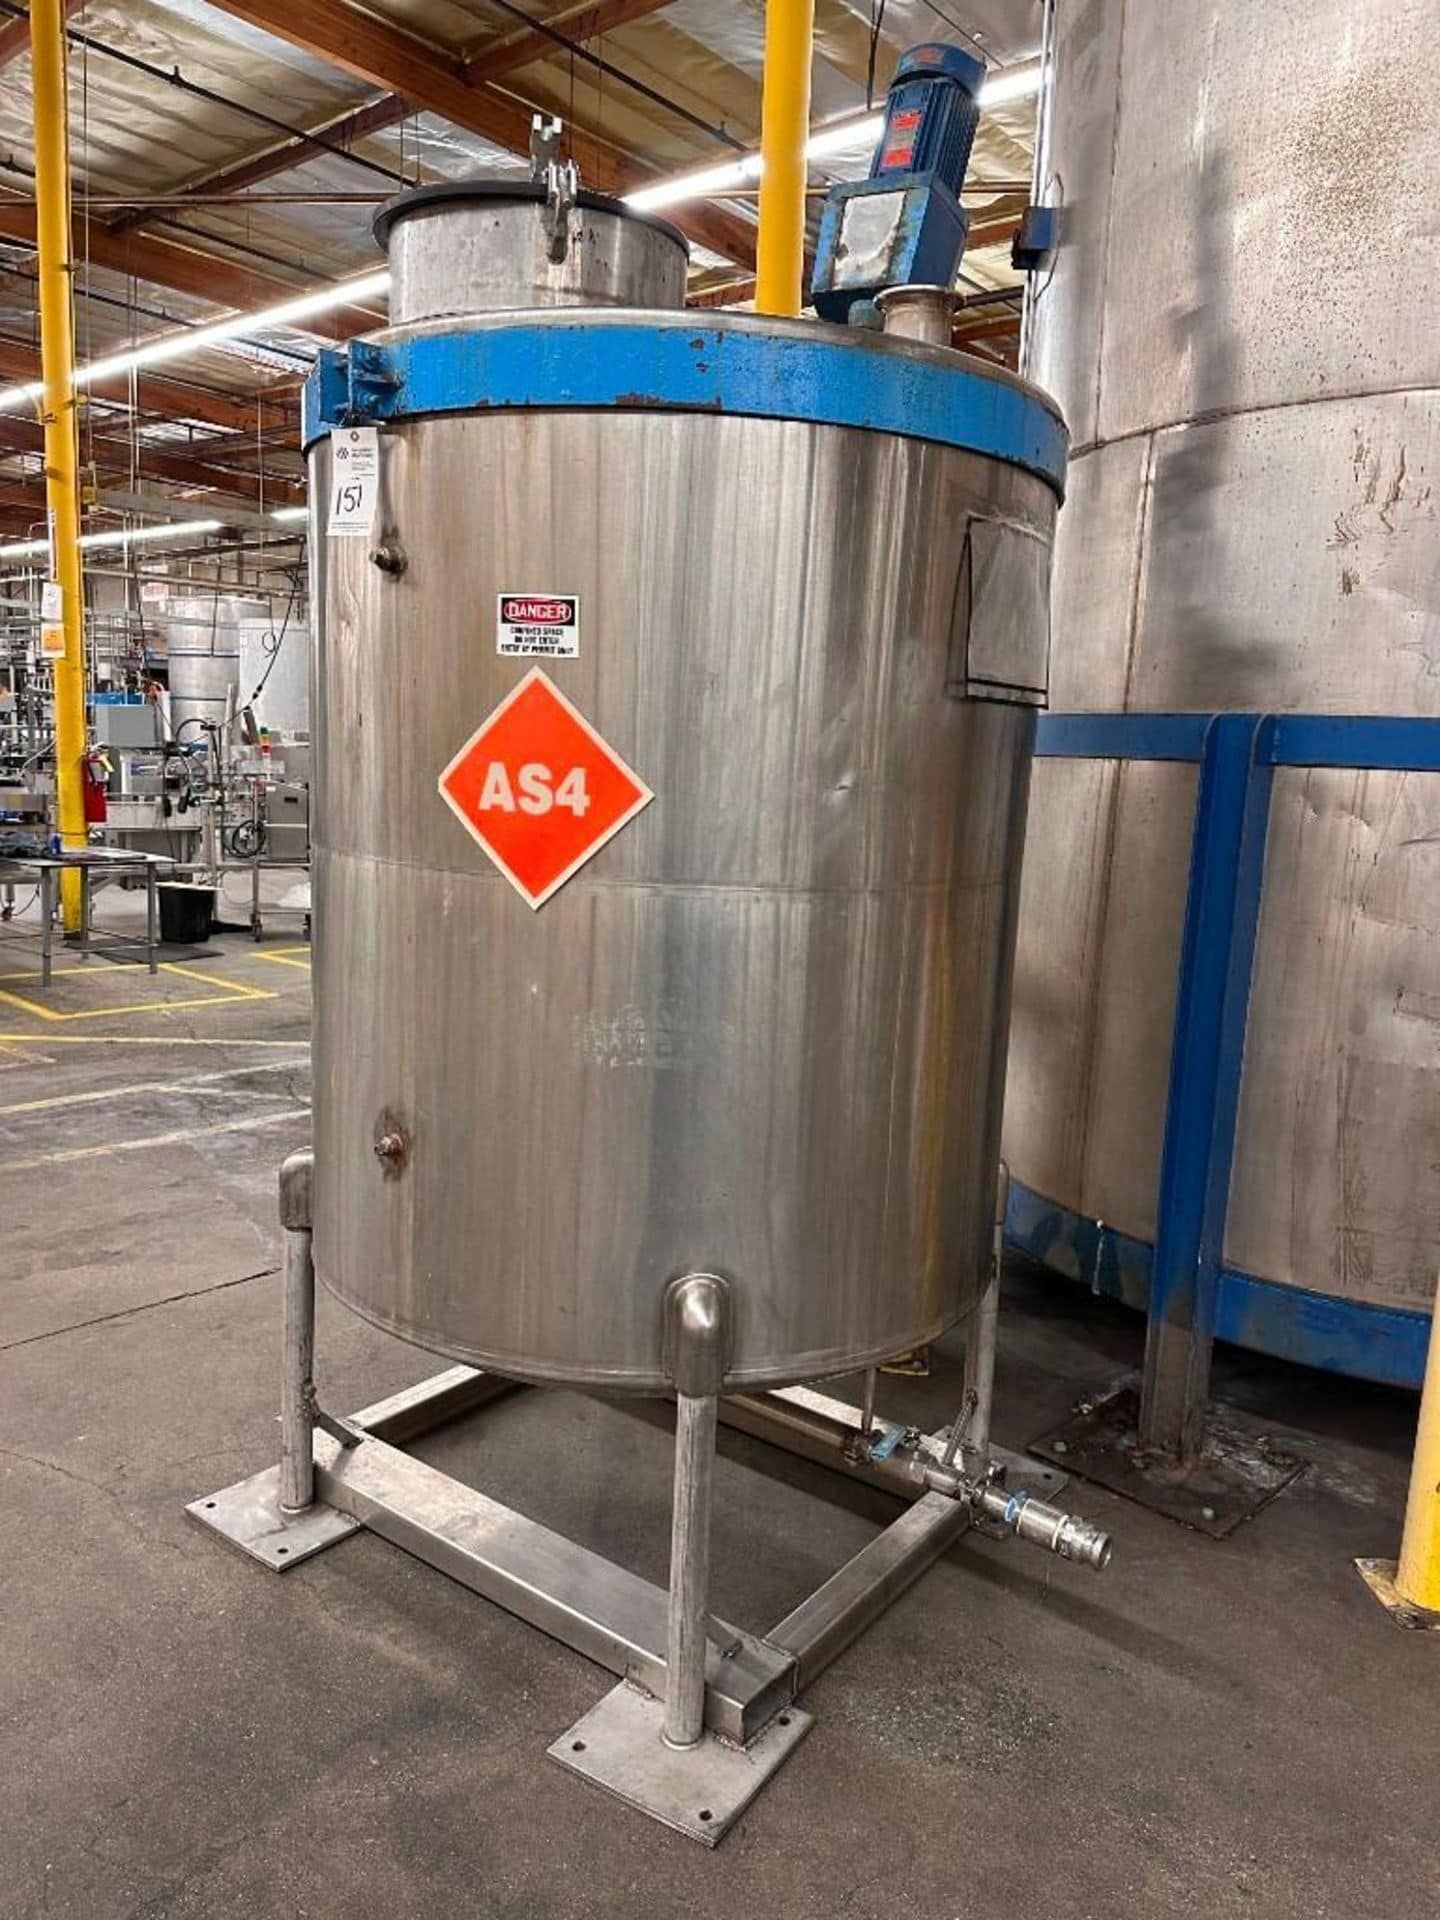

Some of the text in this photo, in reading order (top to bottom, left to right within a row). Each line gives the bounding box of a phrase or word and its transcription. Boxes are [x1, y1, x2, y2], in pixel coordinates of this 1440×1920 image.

[336, 484, 362, 515] 151
[508, 601, 566, 619] DANGER
[479, 760, 591, 817] AS4
